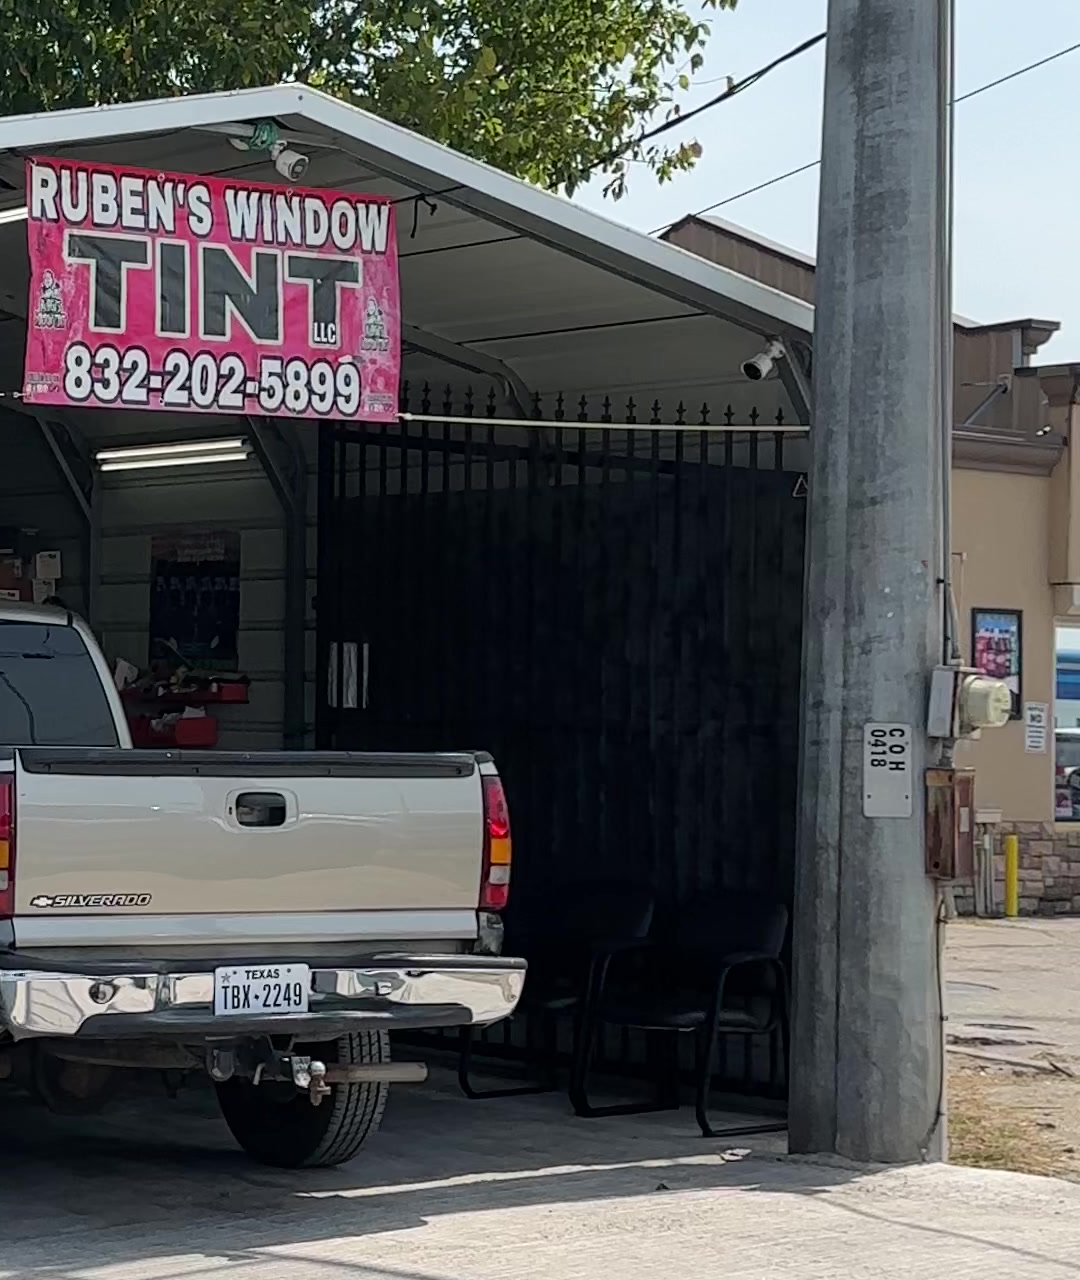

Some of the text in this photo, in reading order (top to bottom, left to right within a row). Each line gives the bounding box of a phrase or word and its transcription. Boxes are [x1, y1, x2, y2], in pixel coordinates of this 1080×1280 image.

[31, 163, 391, 253] RUBEN'S WINDOW
[62, 229, 363, 348] TINT
[313, 320, 337, 345] LLC
[64, 343, 361, 416] 832-202-5899
[870, 728, 888, 767] 0418
[52, 893, 152, 908] SILVERADO
[244, 968, 281, 980] TEXAS
